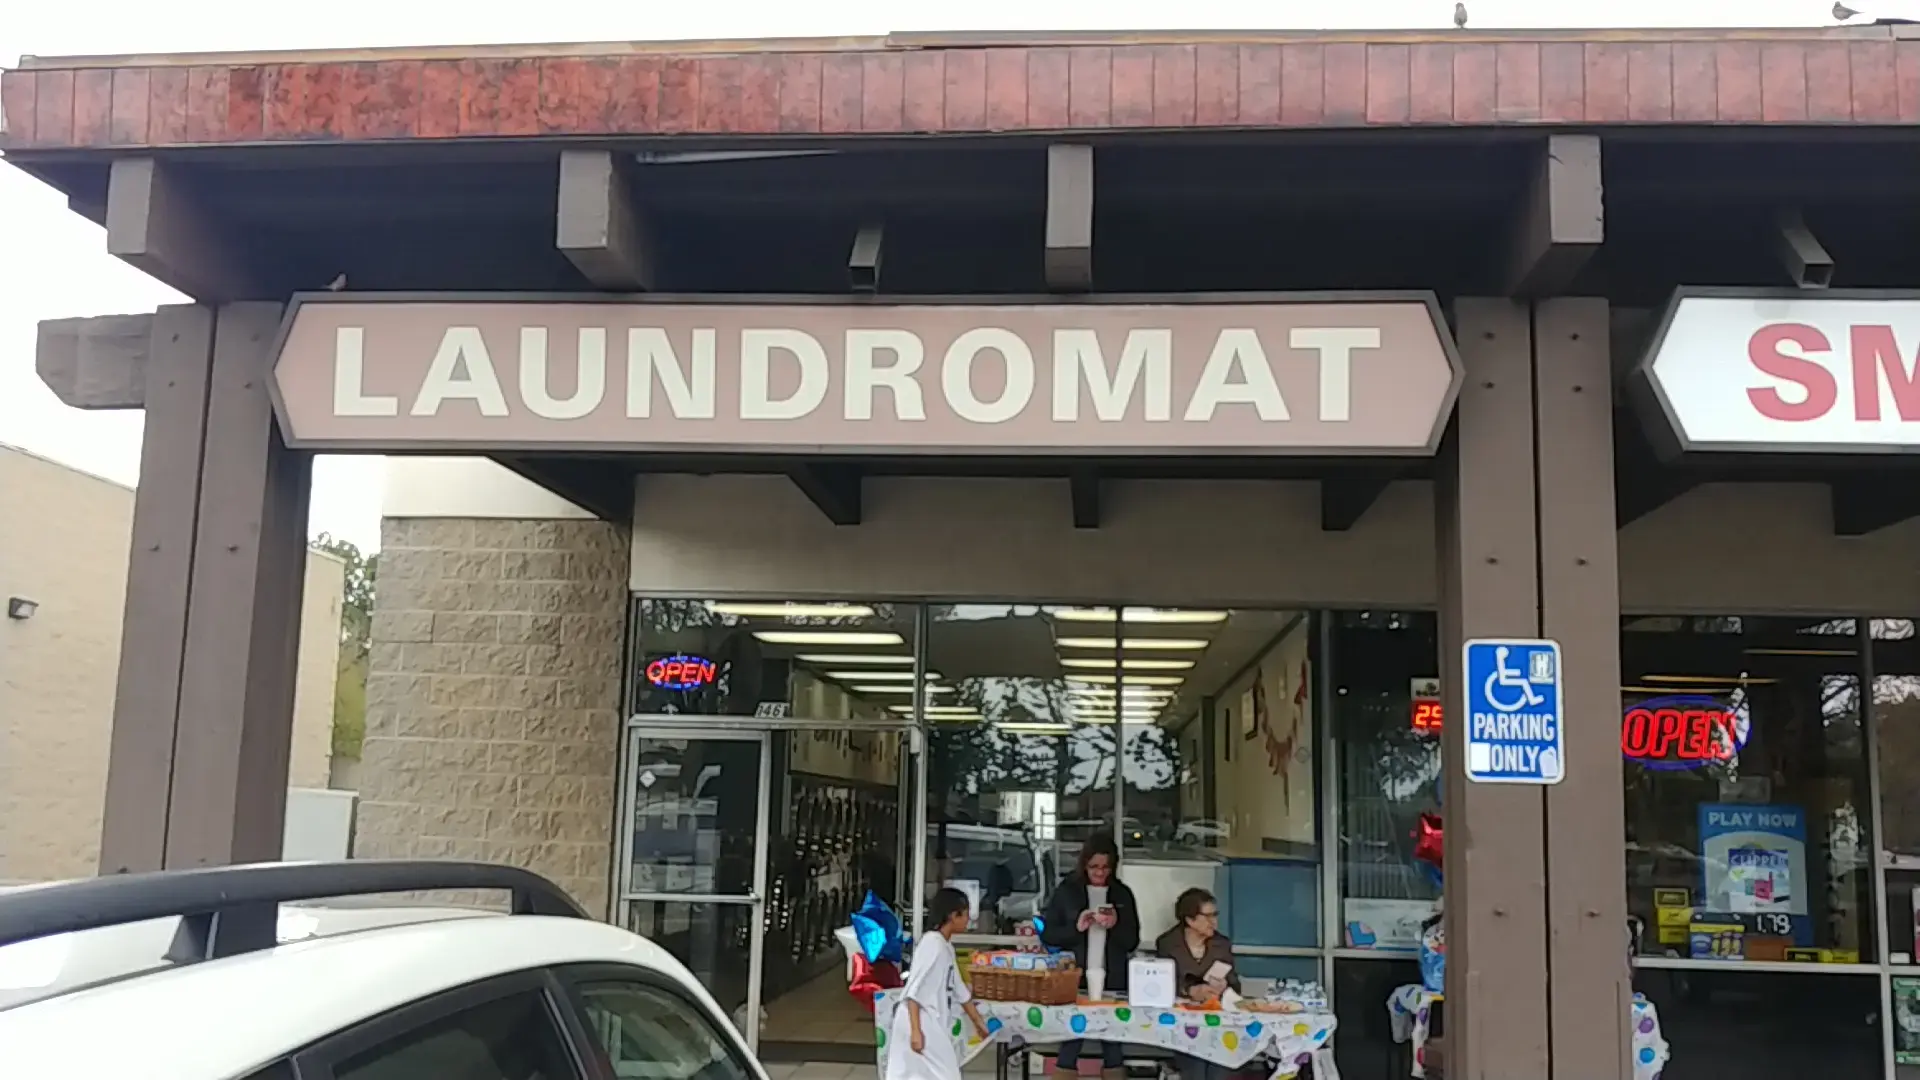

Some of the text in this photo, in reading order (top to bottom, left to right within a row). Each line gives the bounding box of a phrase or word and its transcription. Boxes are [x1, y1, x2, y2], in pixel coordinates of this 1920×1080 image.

[332, 325, 1382, 422] LAUNDROMAT
[646, 660, 717, 684] OPEN
[1473, 712, 1556, 742] PARKING
[1621, 708, 1737, 759] OPEN
[1491, 743, 1542, 773] ONLY
[1708, 811, 1797, 828] PLAY NOW
